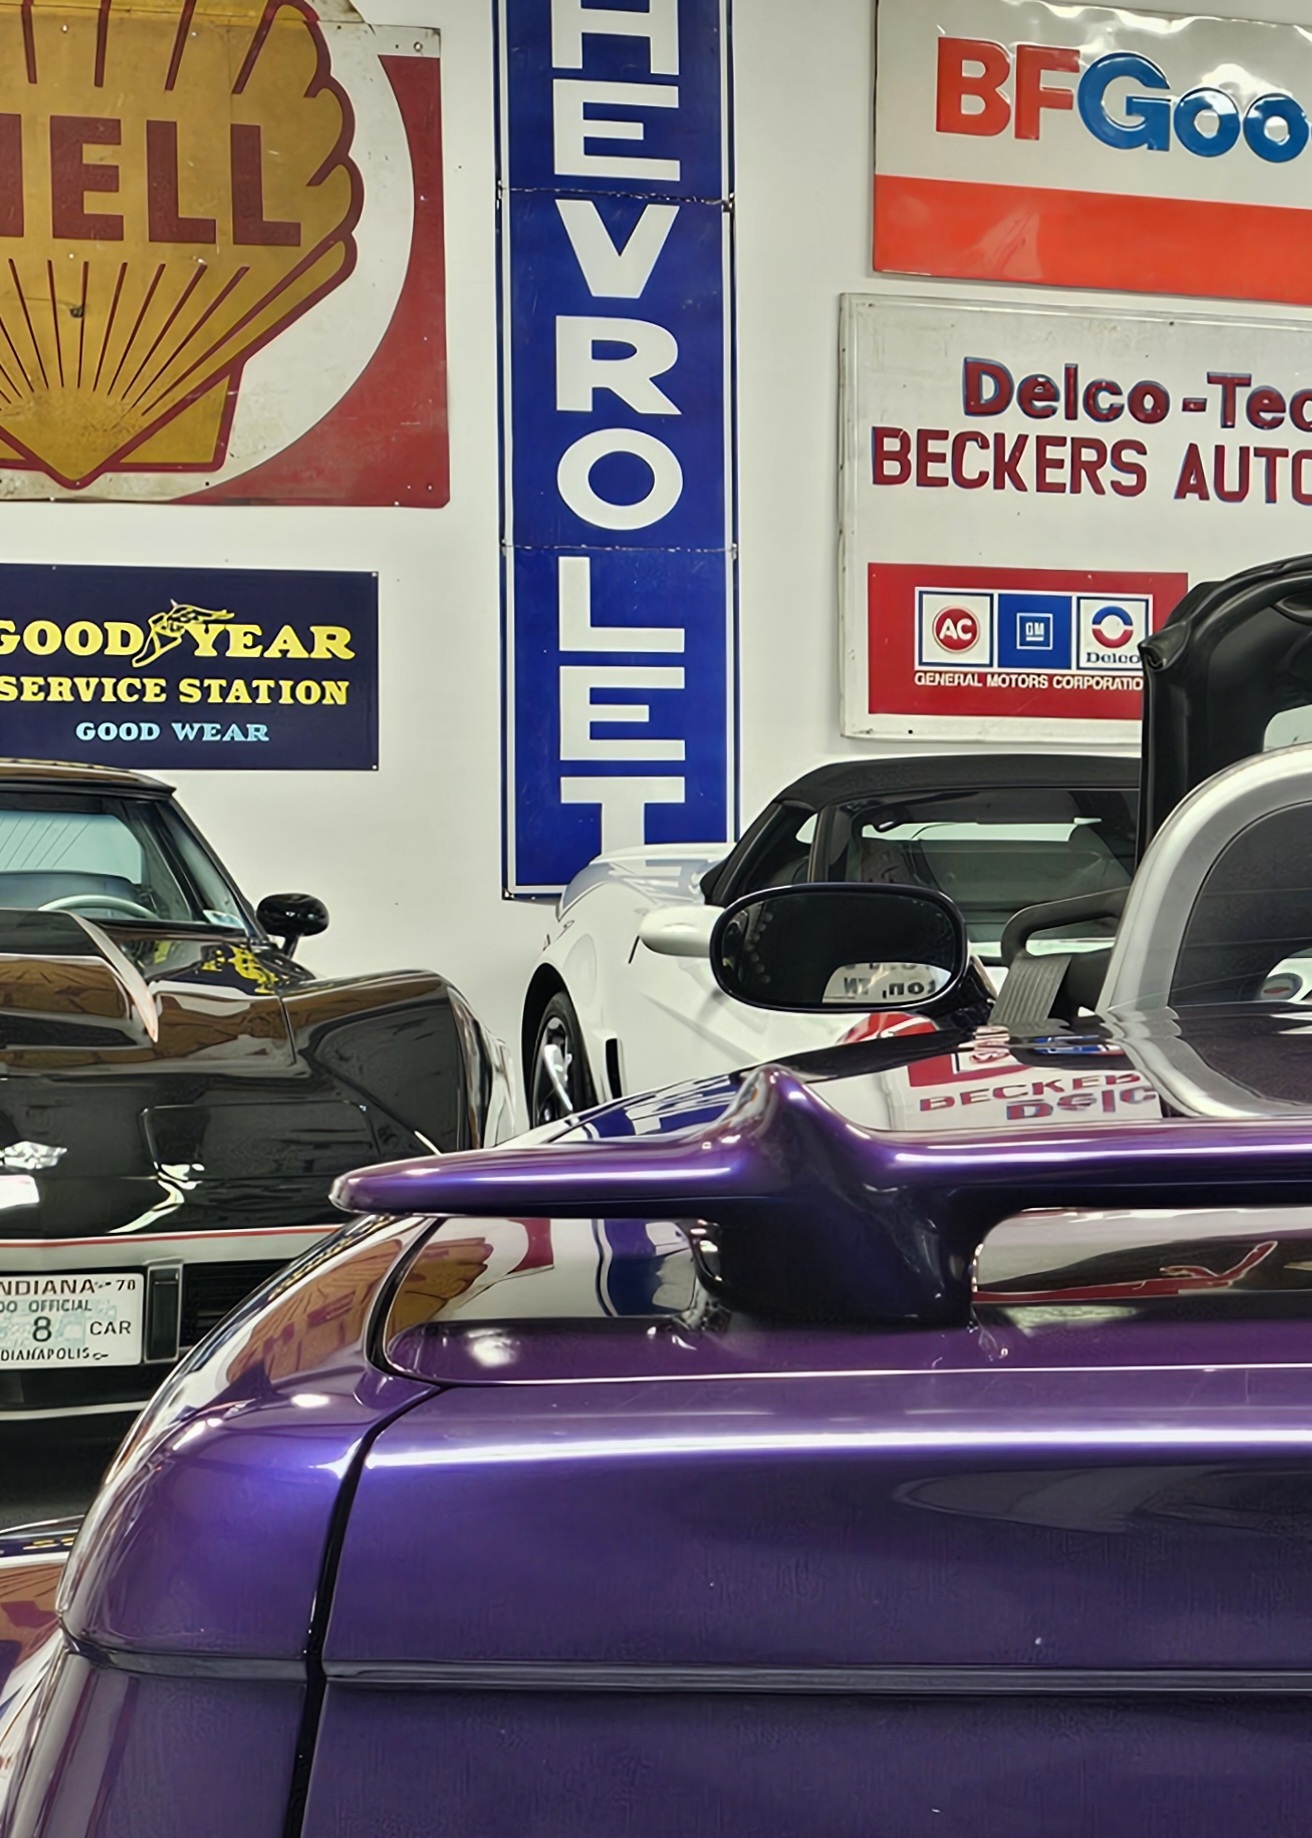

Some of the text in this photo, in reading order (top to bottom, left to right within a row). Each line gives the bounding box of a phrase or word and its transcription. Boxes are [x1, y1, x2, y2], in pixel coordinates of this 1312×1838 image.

[872, 426, 1148, 497] BECKERS
[939, 618, 973, 640] AC
[1025, 621, 1045, 637] GM
[1086, 652, 1140, 664] Delco
[0, 676, 349, 705] SERVICE STATION
[914, 672, 1144, 691] GENERAL MOTORS CORPORATIO
[76, 722, 270, 742] GOOD WEAR
[28, 1299, 93, 1313] OFFICIAL
[32, 1316, 132, 1342] 8 CAR
